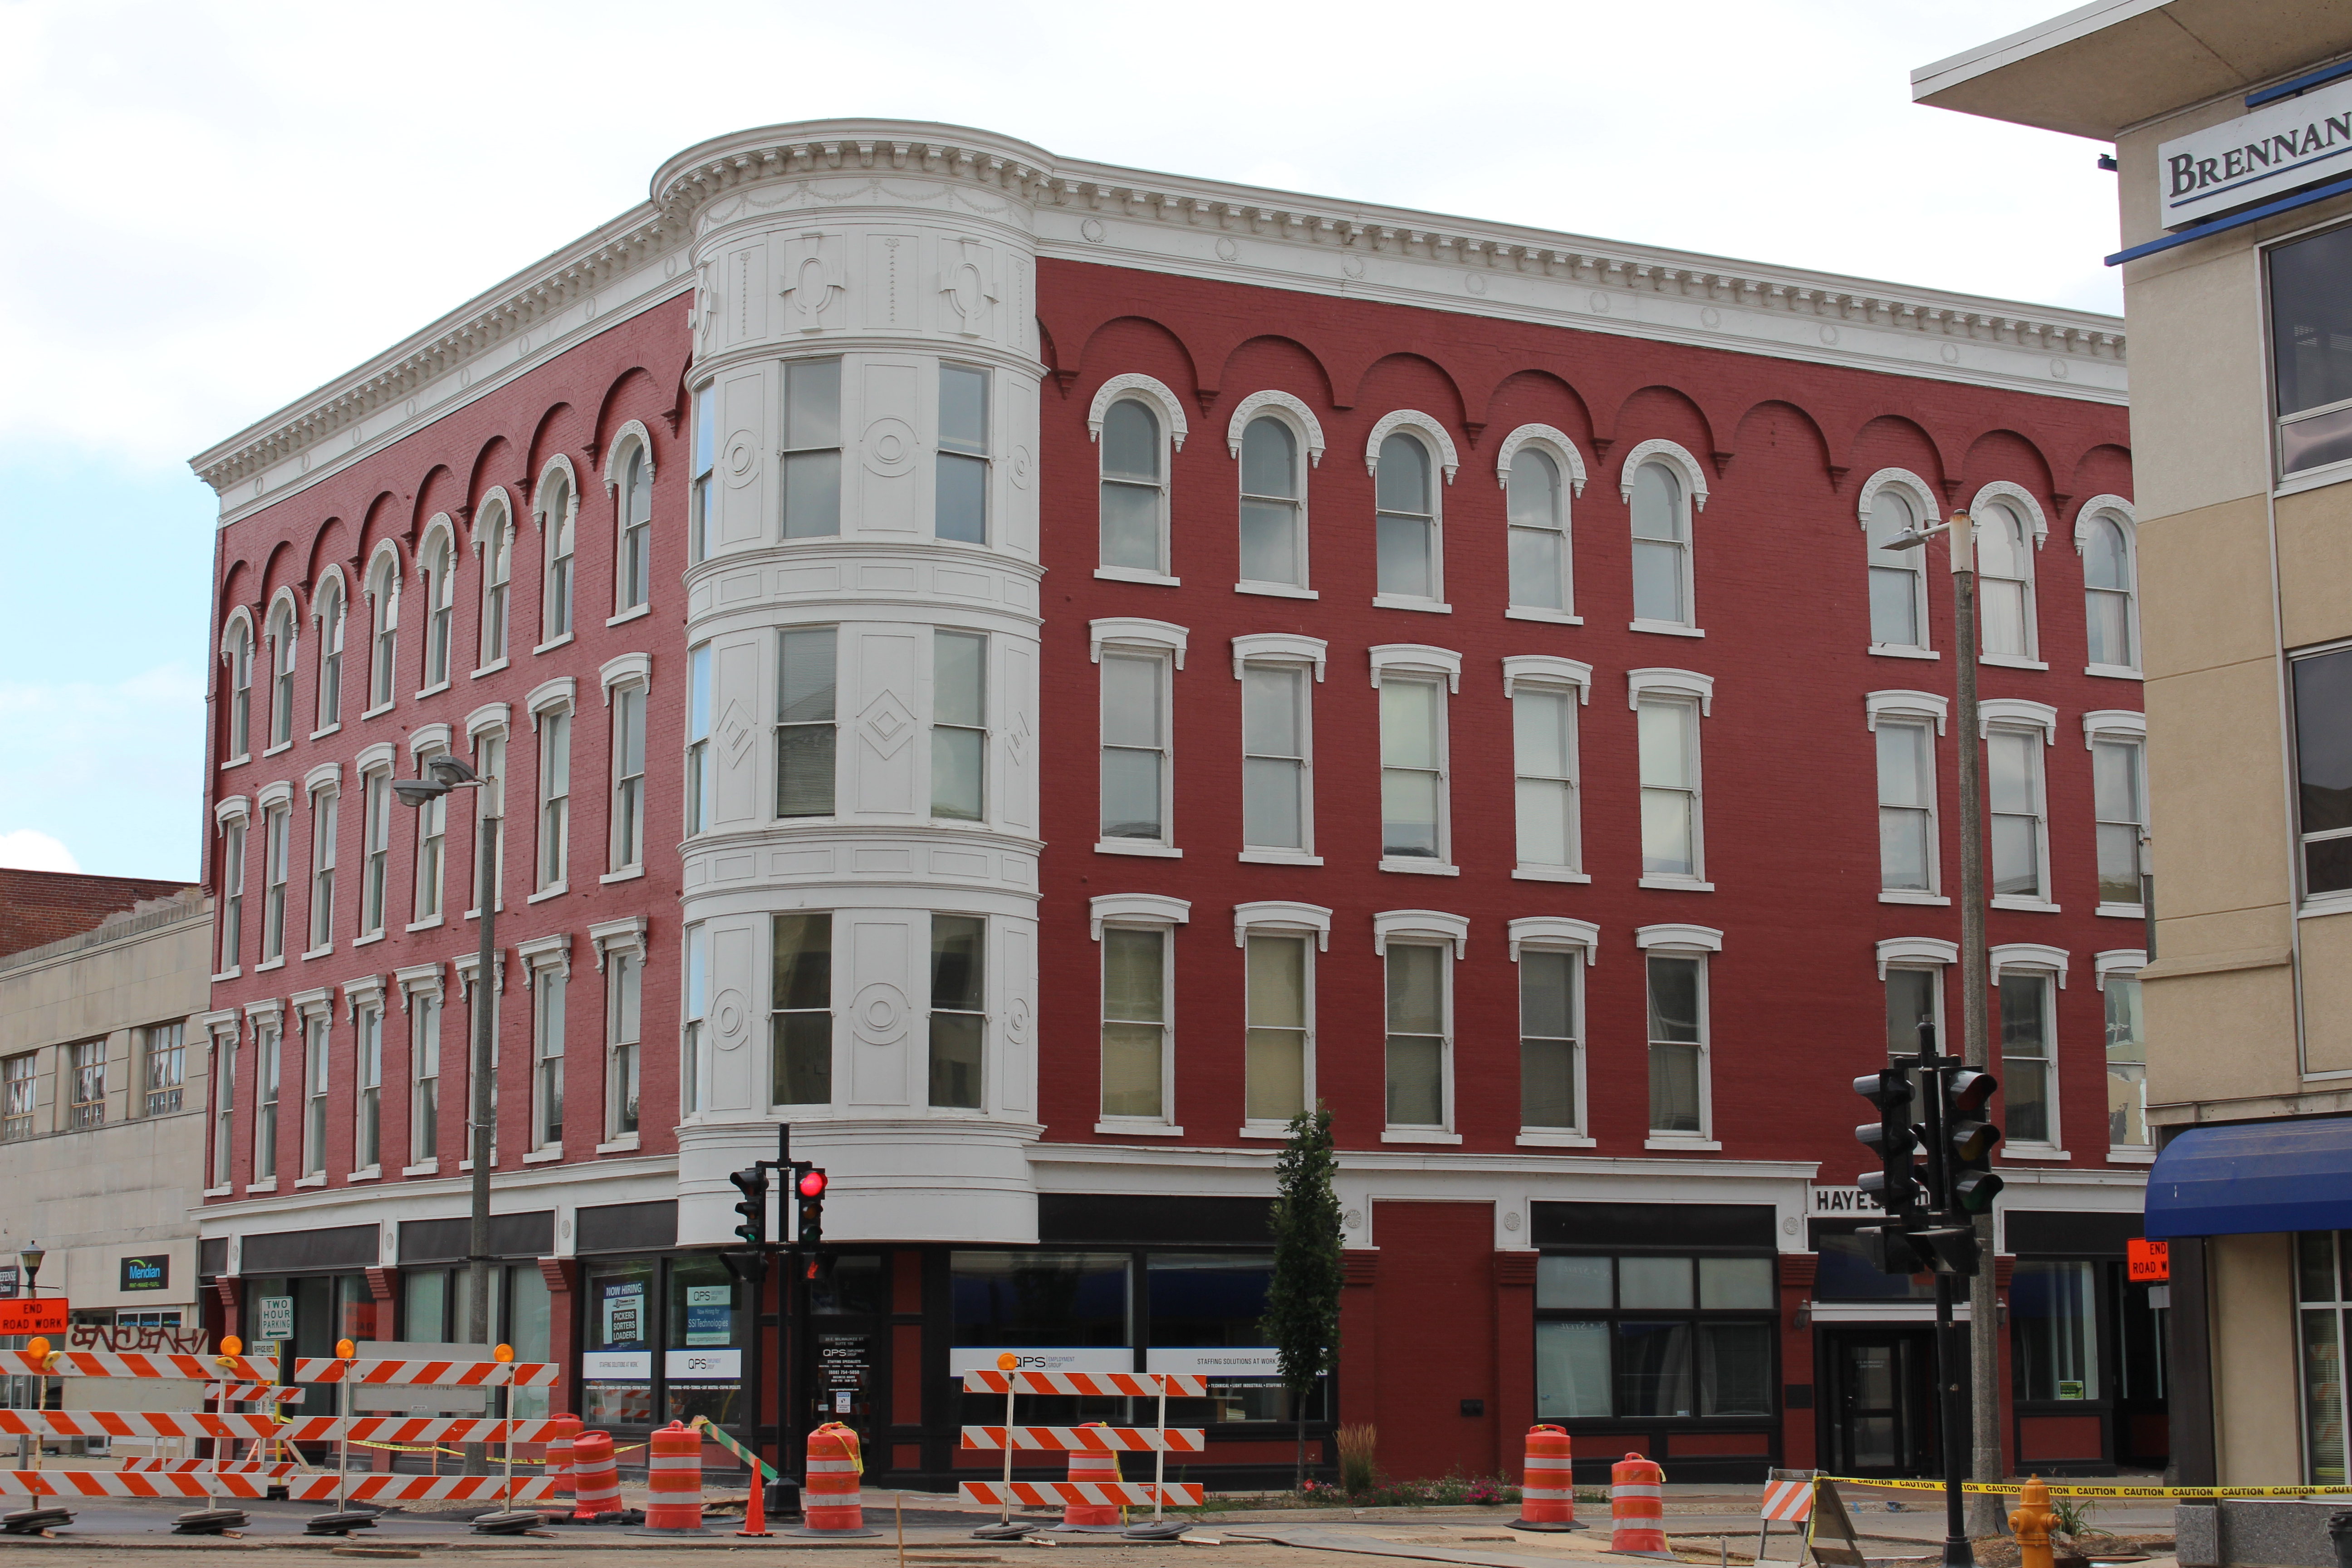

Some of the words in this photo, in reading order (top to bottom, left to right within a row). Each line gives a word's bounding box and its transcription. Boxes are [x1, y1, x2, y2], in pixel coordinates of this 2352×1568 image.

[2168, 112, 2352, 198] BRENNAN
[2150, 1243, 2166, 1255] END
[129, 1263, 160, 1279] Meridian
[2133, 1263, 2156, 1274] ROAD
[0, 1271, 17, 1281] EFENSE
[606, 1286, 621, 1296] NOW
[622, 1283, 642, 1294] HIRING
[694, 1291, 710, 1301] QPS
[24, 1304, 42, 1314] END
[266, 1300, 287, 1308] TWO
[264, 1310, 290, 1319] HOUR
[614, 1311, 635, 1321] PICKERS
[3, 1319, 29, 1329] ROAD
[35, 1318, 63, 1328] WORK
[263, 1320, 290, 1329] PARKING
[613, 1321, 635, 1331] SORTERS
[613, 1331, 636, 1341] LOADERS
[688, 1358, 706, 1369] QPS
[1899, 1480, 1936, 1489] CAUTION
[1985, 1485, 2023, 1493] CAUTION
[2077, 1487, 2116, 1495] CAUTION
[2221, 1488, 2264, 1496] CAUTION
[2272, 1487, 2316, 1495] CAUTION
